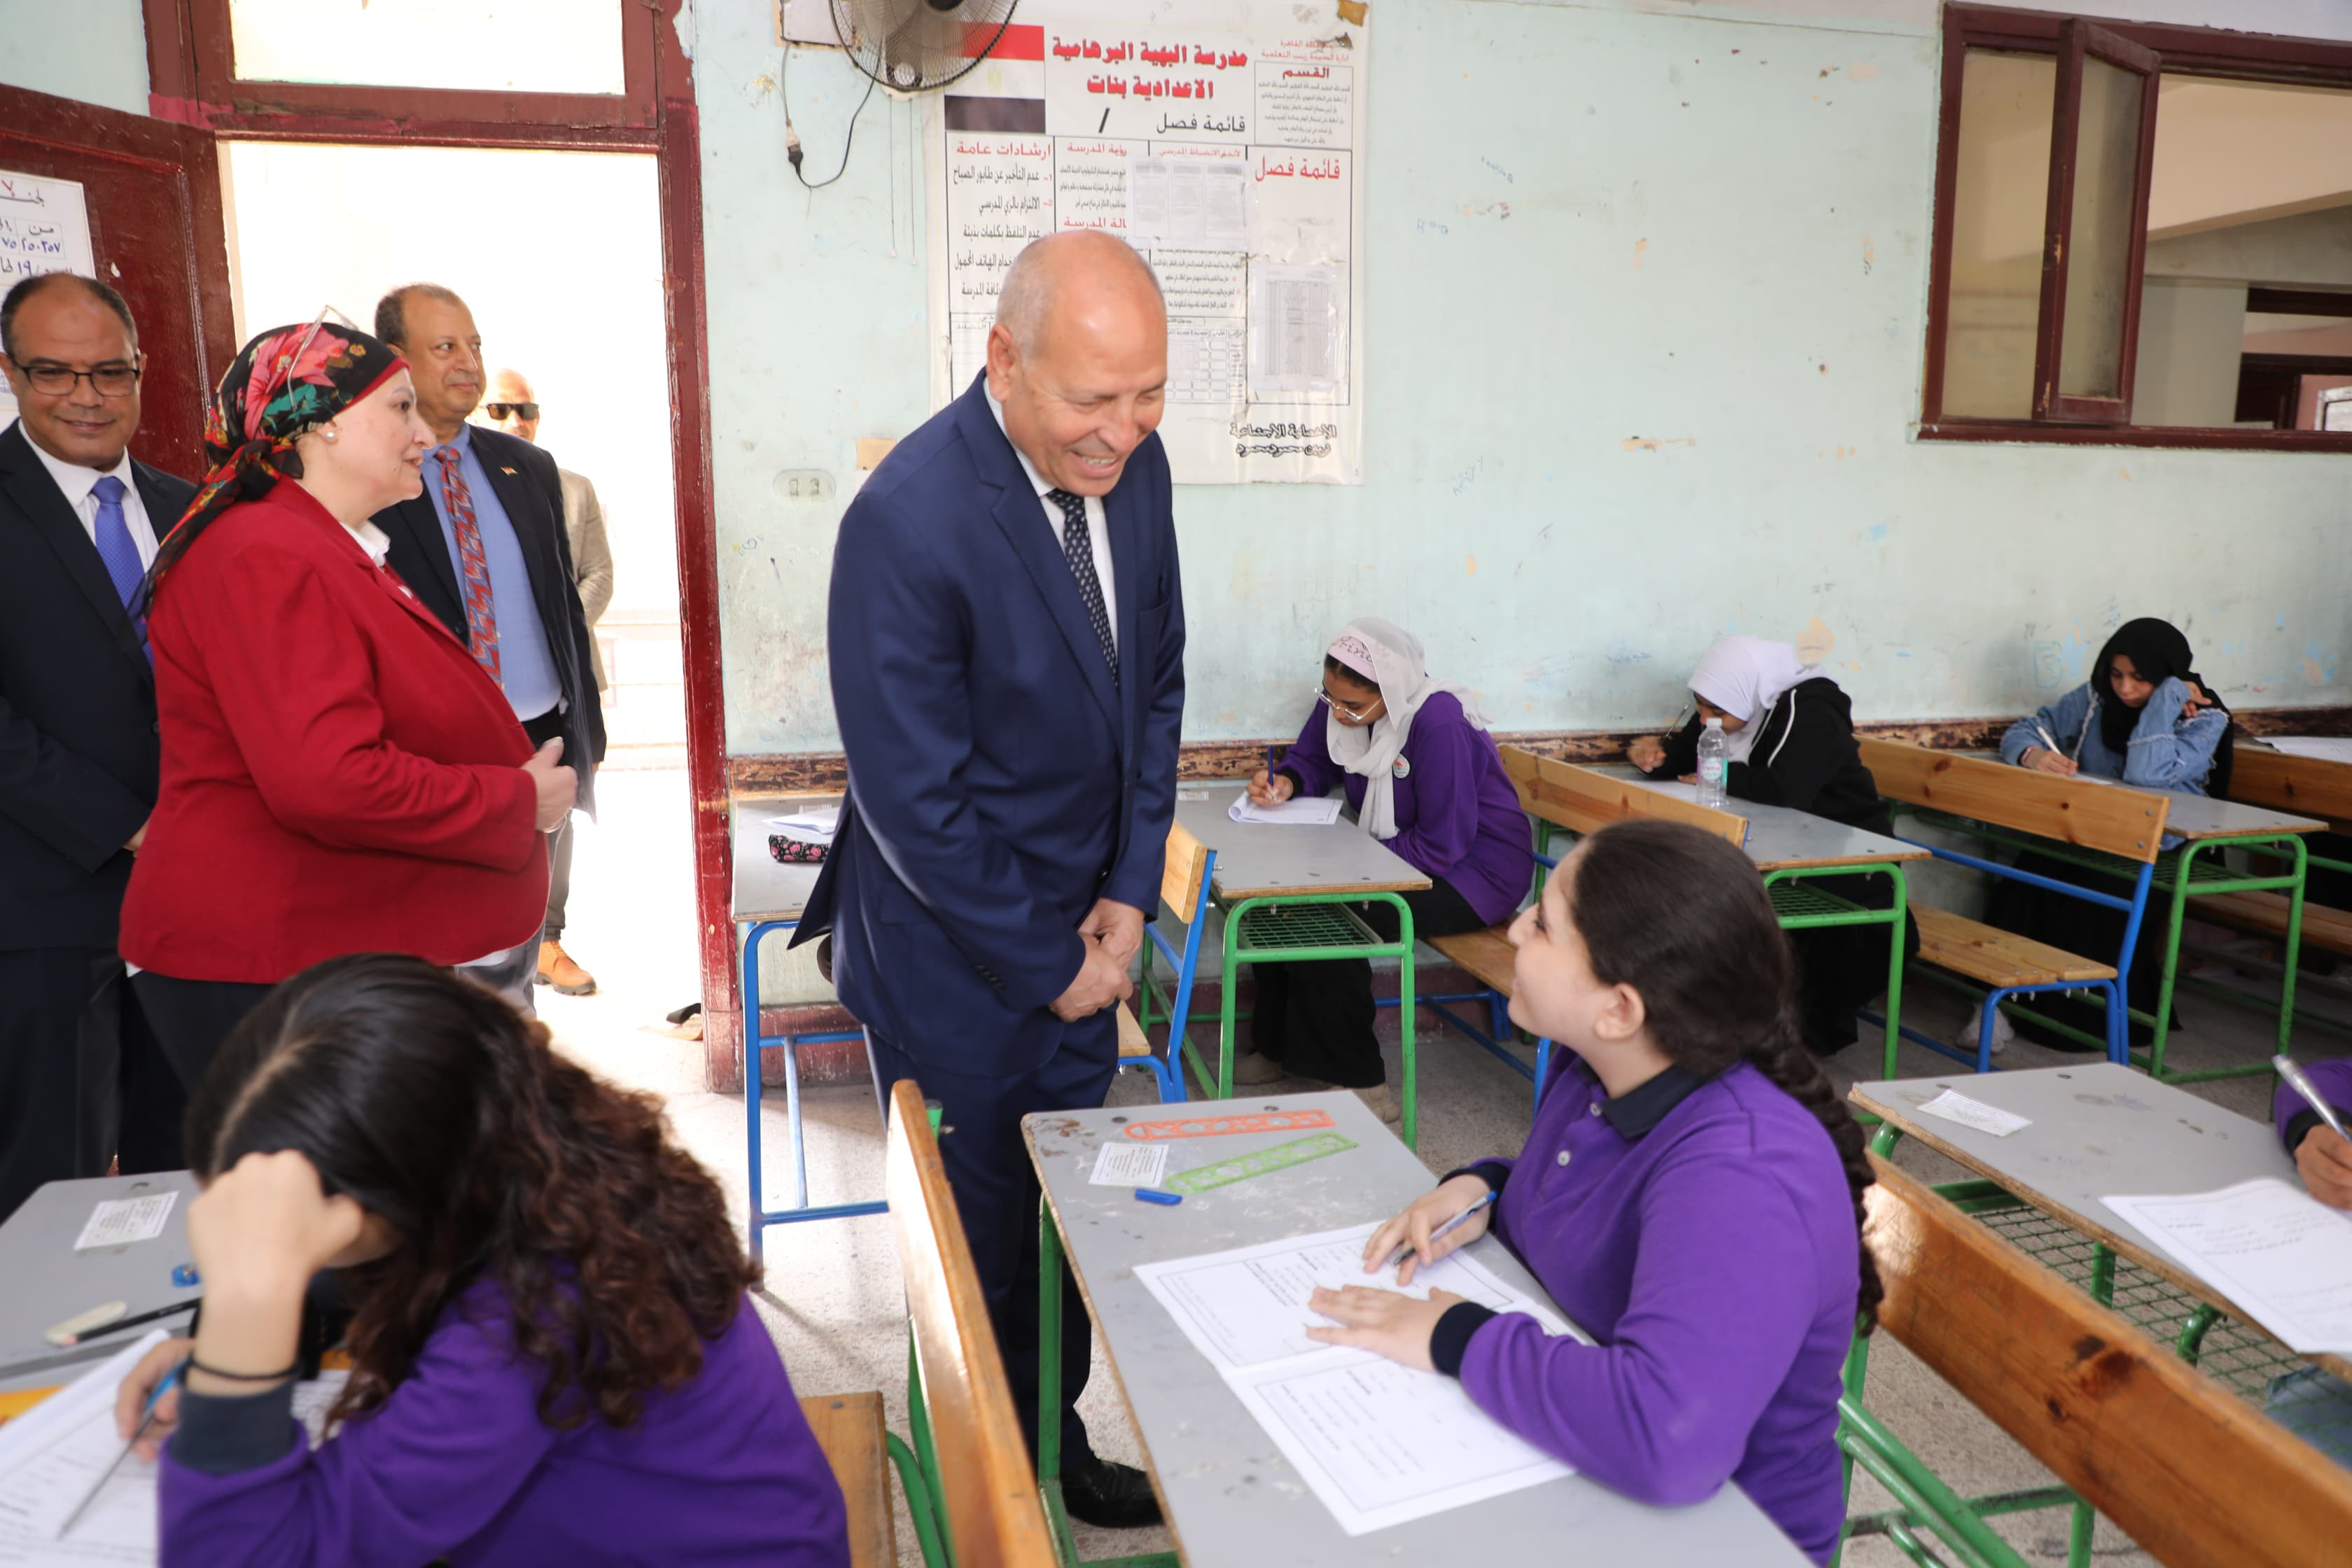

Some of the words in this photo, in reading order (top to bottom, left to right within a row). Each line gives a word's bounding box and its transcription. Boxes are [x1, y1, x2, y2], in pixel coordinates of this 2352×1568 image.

[1052, 36, 1134, 64] البرهامية
[1140, 41, 1187, 67] البهية
[1194, 44, 1247, 70] مدرسة
[1282, 66, 1330, 80] القسم
[1087, 74, 1126, 99] بنات
[1133, 75, 1214, 101] الاعدادية
[1156, 112, 1198, 134] فصل
[1203, 115, 1245, 133] قائمة
[956, 141, 991, 155] عامة
[997, 141, 1051, 160] ارشادات
[1068, 142, 1105, 155] المدرسة
[953, 164, 975, 185] الصباح
[1027, 171, 1040, 187] عدم
[1255, 155, 1294, 182] فصل
[1300, 158, 1340, 180] قائمة
[1063, 214, 1107, 229] المدرسة
[962, 281, 984, 300] المدرسة
